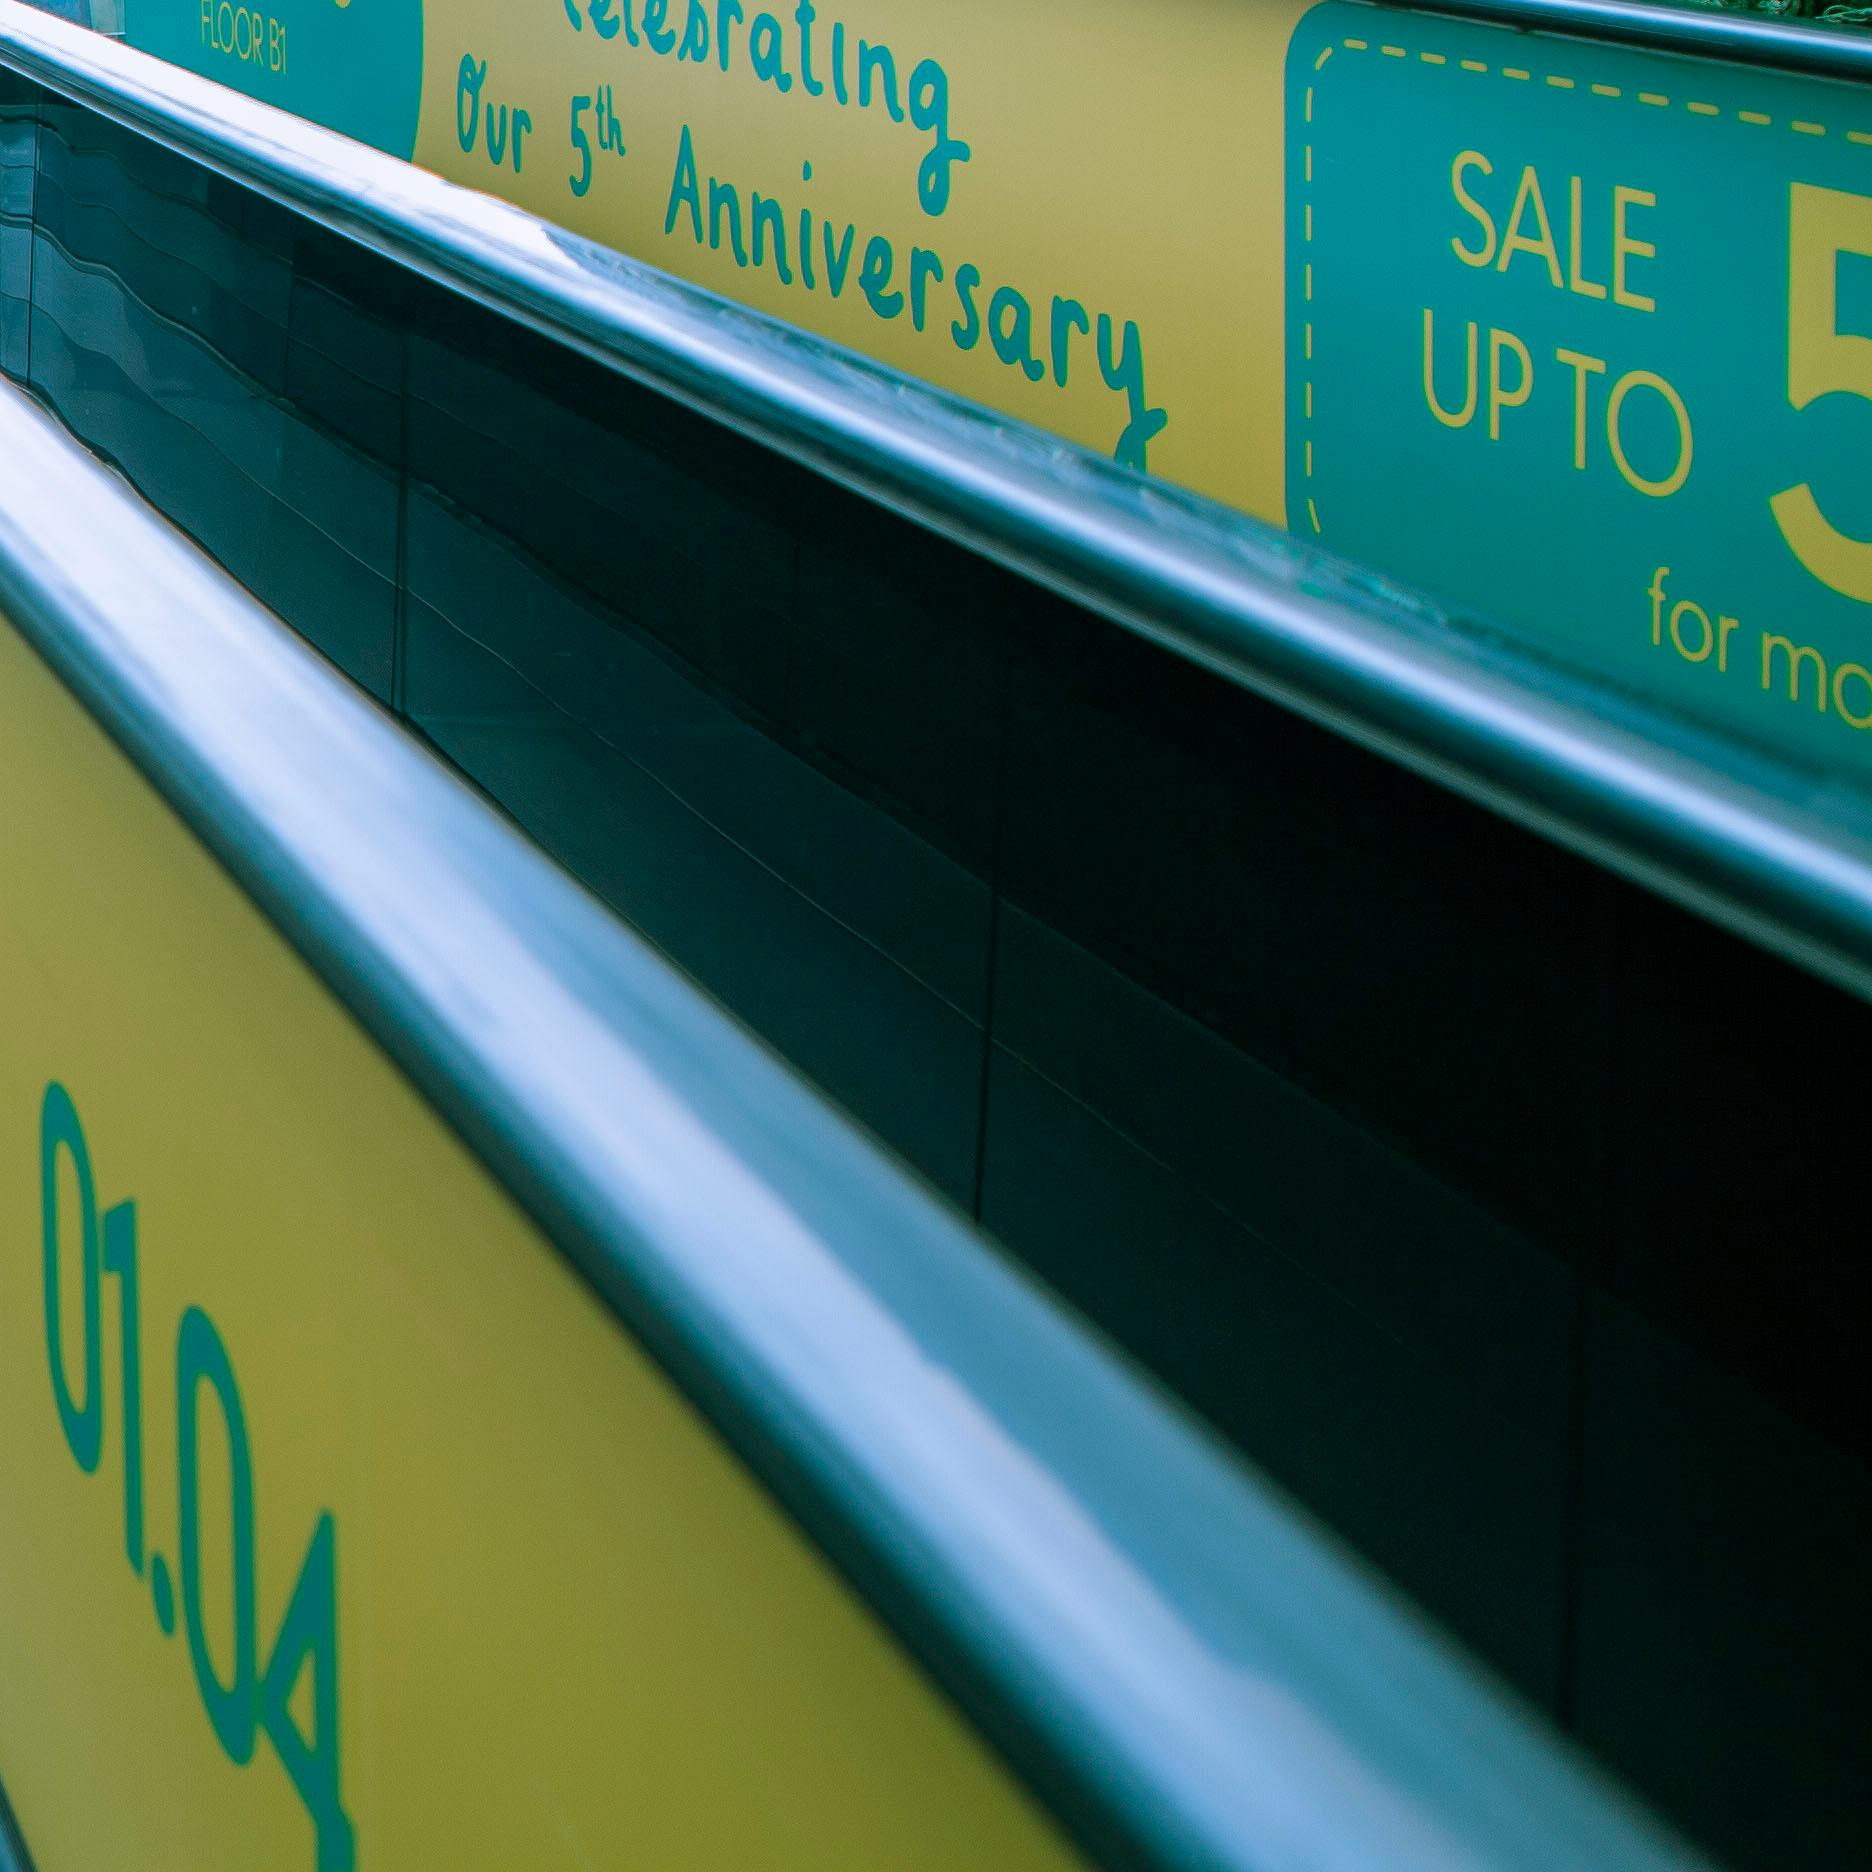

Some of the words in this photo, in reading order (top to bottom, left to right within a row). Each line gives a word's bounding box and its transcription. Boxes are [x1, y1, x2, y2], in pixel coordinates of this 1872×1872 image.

[269, 17, 287, 75] B1
[456, 53, 532, 173] Our
[569, 84, 626, 197] 5th
[665, 124, 1168, 475] Anniversary
[1450, 149, 1656, 313] SALE
[1422, 308, 1534, 441] UP
[1556, 348, 1694, 498] TO
[1647, 566, 1740, 673] for
